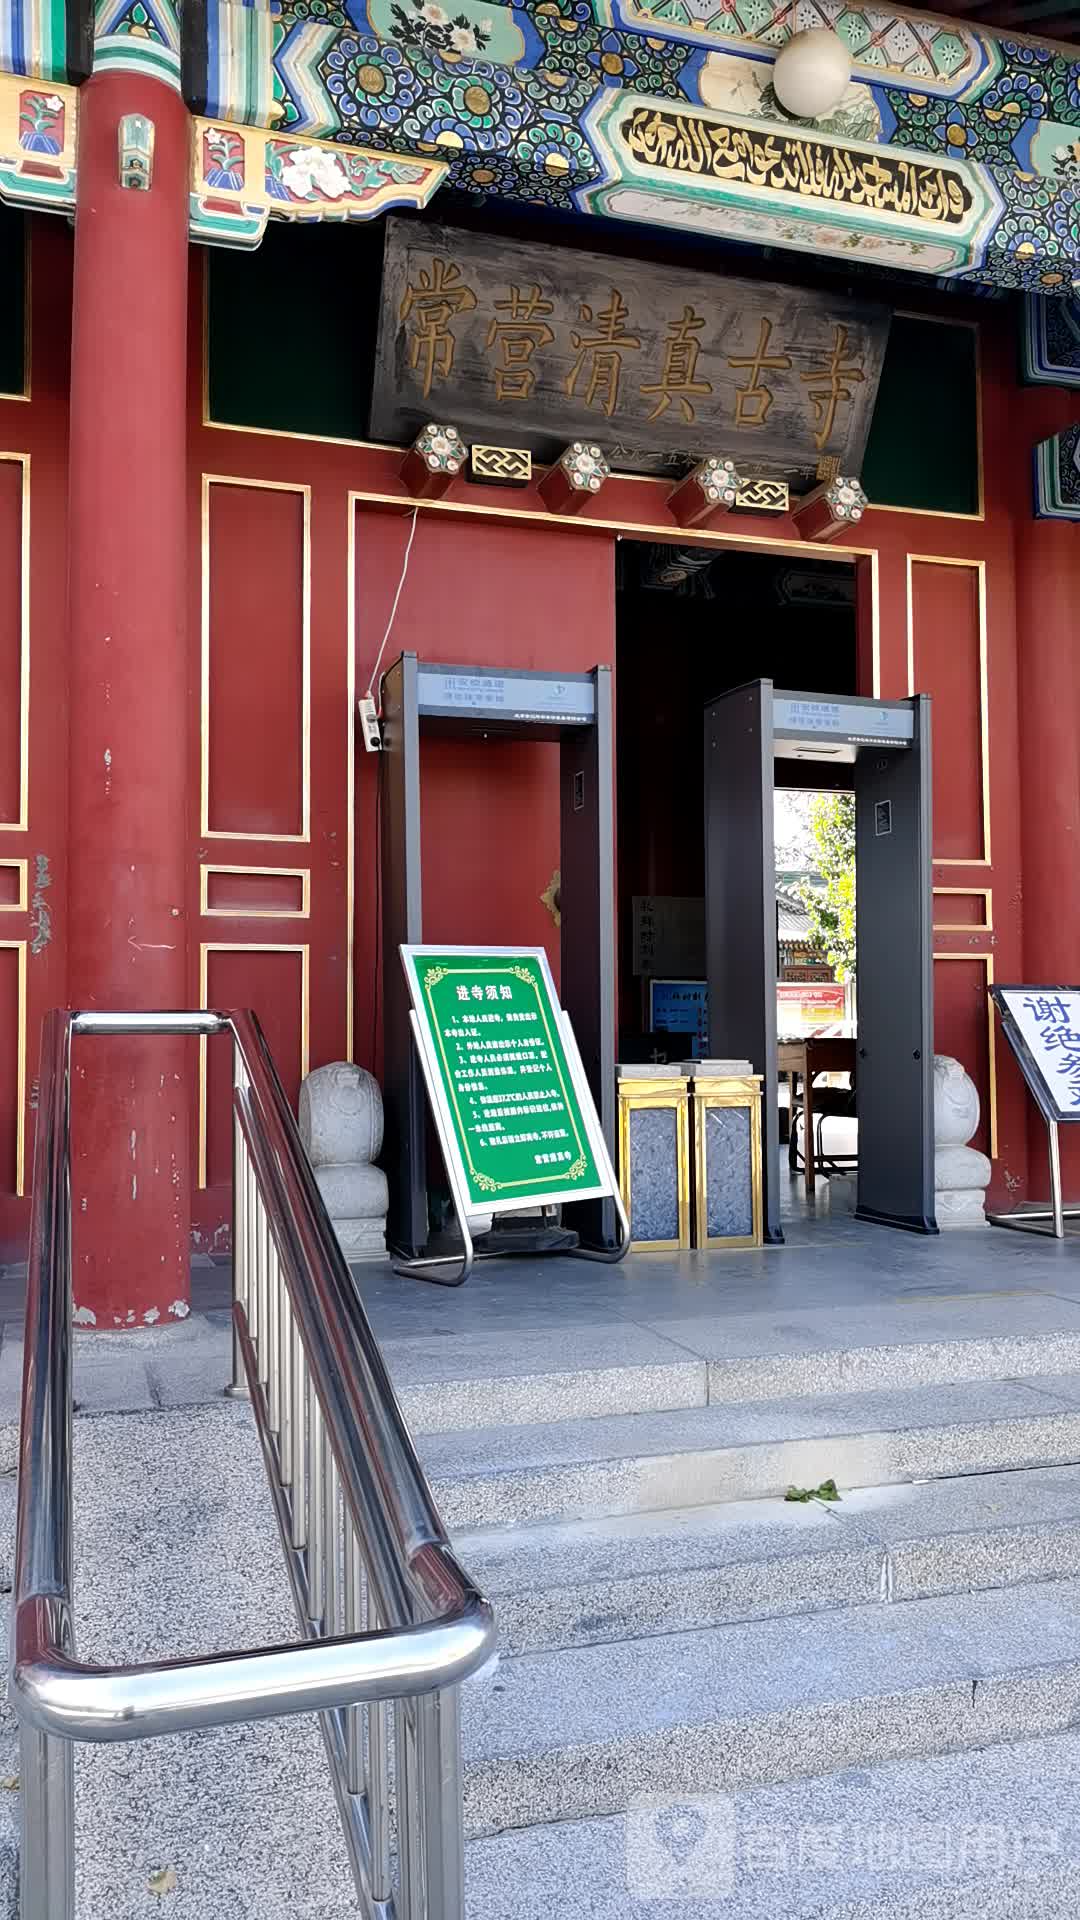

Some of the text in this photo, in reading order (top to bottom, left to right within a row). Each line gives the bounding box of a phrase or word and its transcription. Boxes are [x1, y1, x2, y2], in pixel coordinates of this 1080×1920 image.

[400, 256, 866, 450] 常营清真古寺
[455, 984, 513, 1001] 进寺须知
